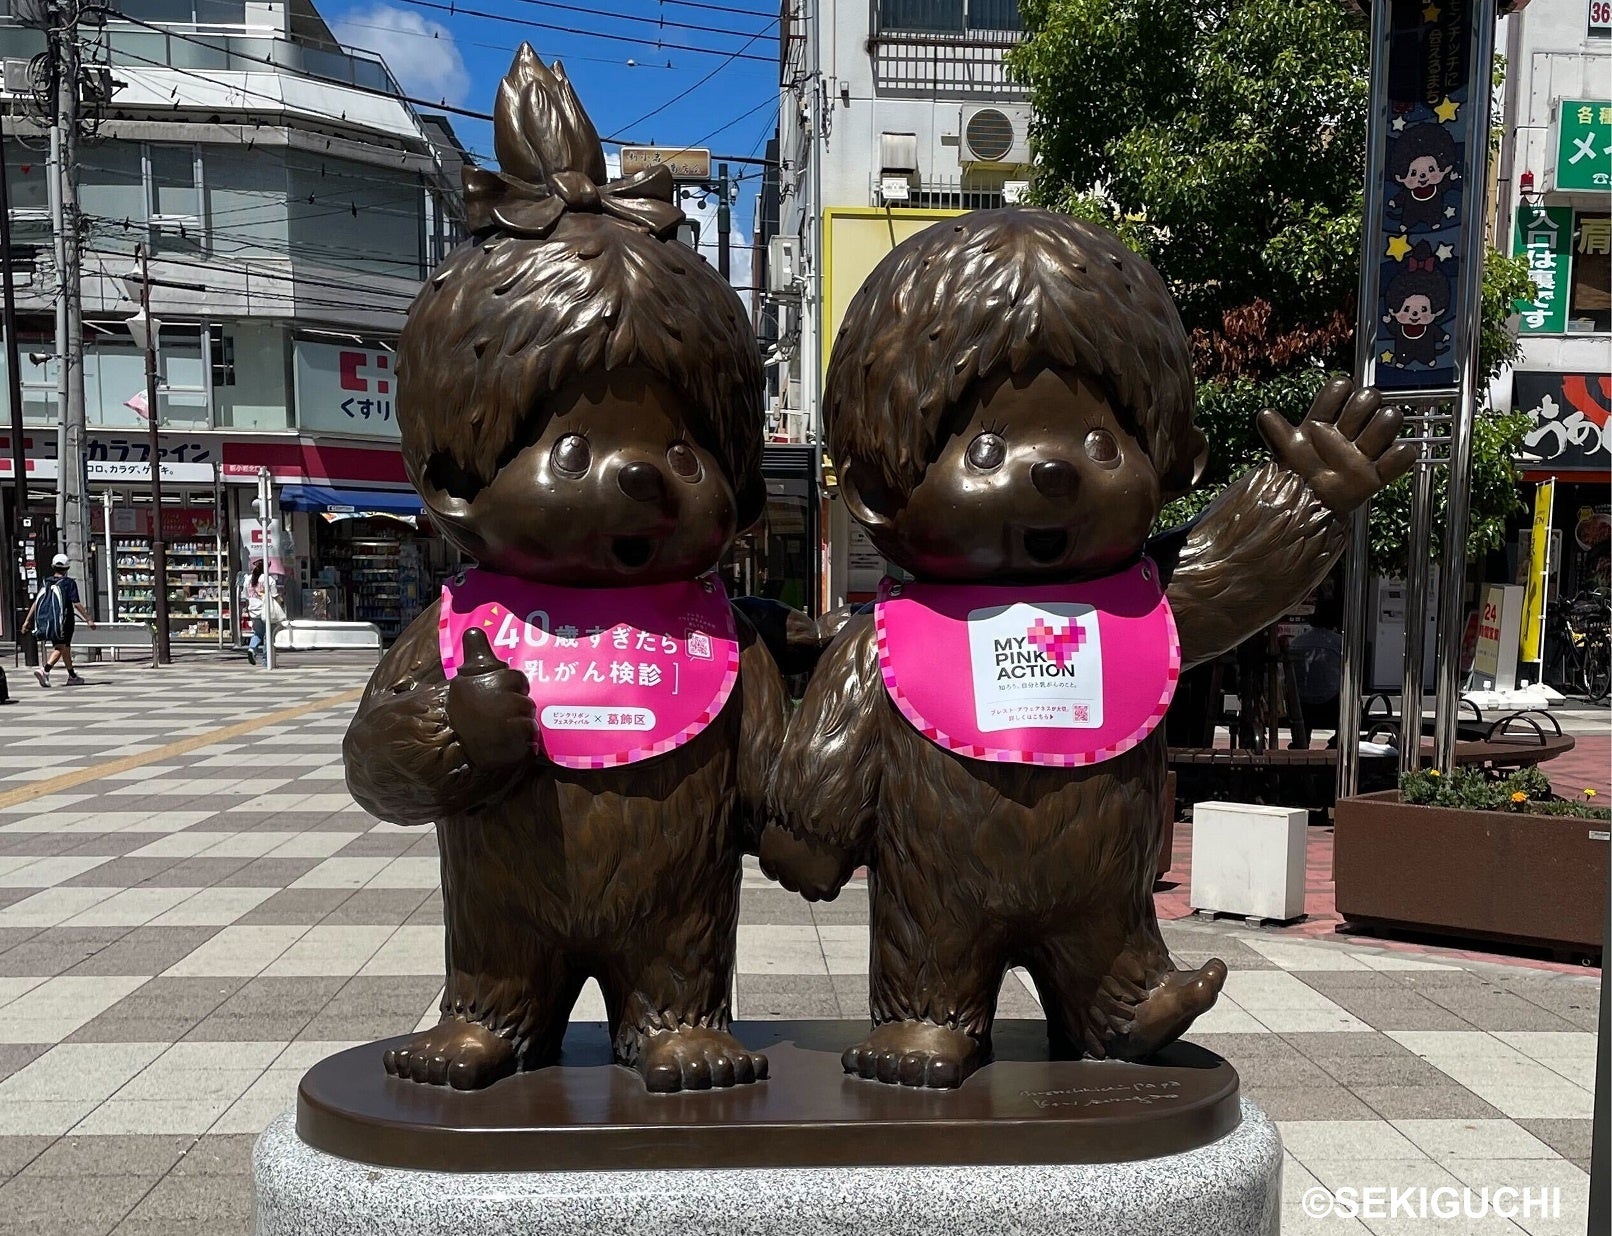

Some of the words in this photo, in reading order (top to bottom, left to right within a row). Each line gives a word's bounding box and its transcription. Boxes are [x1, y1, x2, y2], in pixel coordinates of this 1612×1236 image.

[1568, 131, 1611, 165] メ
[340, 398, 390, 421] くすり
[44, 438, 210, 463] コカラファイン
[1484, 603, 1497, 622] 24
[493, 610, 678, 654] 40歳すぎたら
[994, 636, 1026, 652] MY
[995, 650, 1048, 666] PINK
[997, 663, 1075, 681] ACTION
[608, 713, 646, 725] 葛飾区
